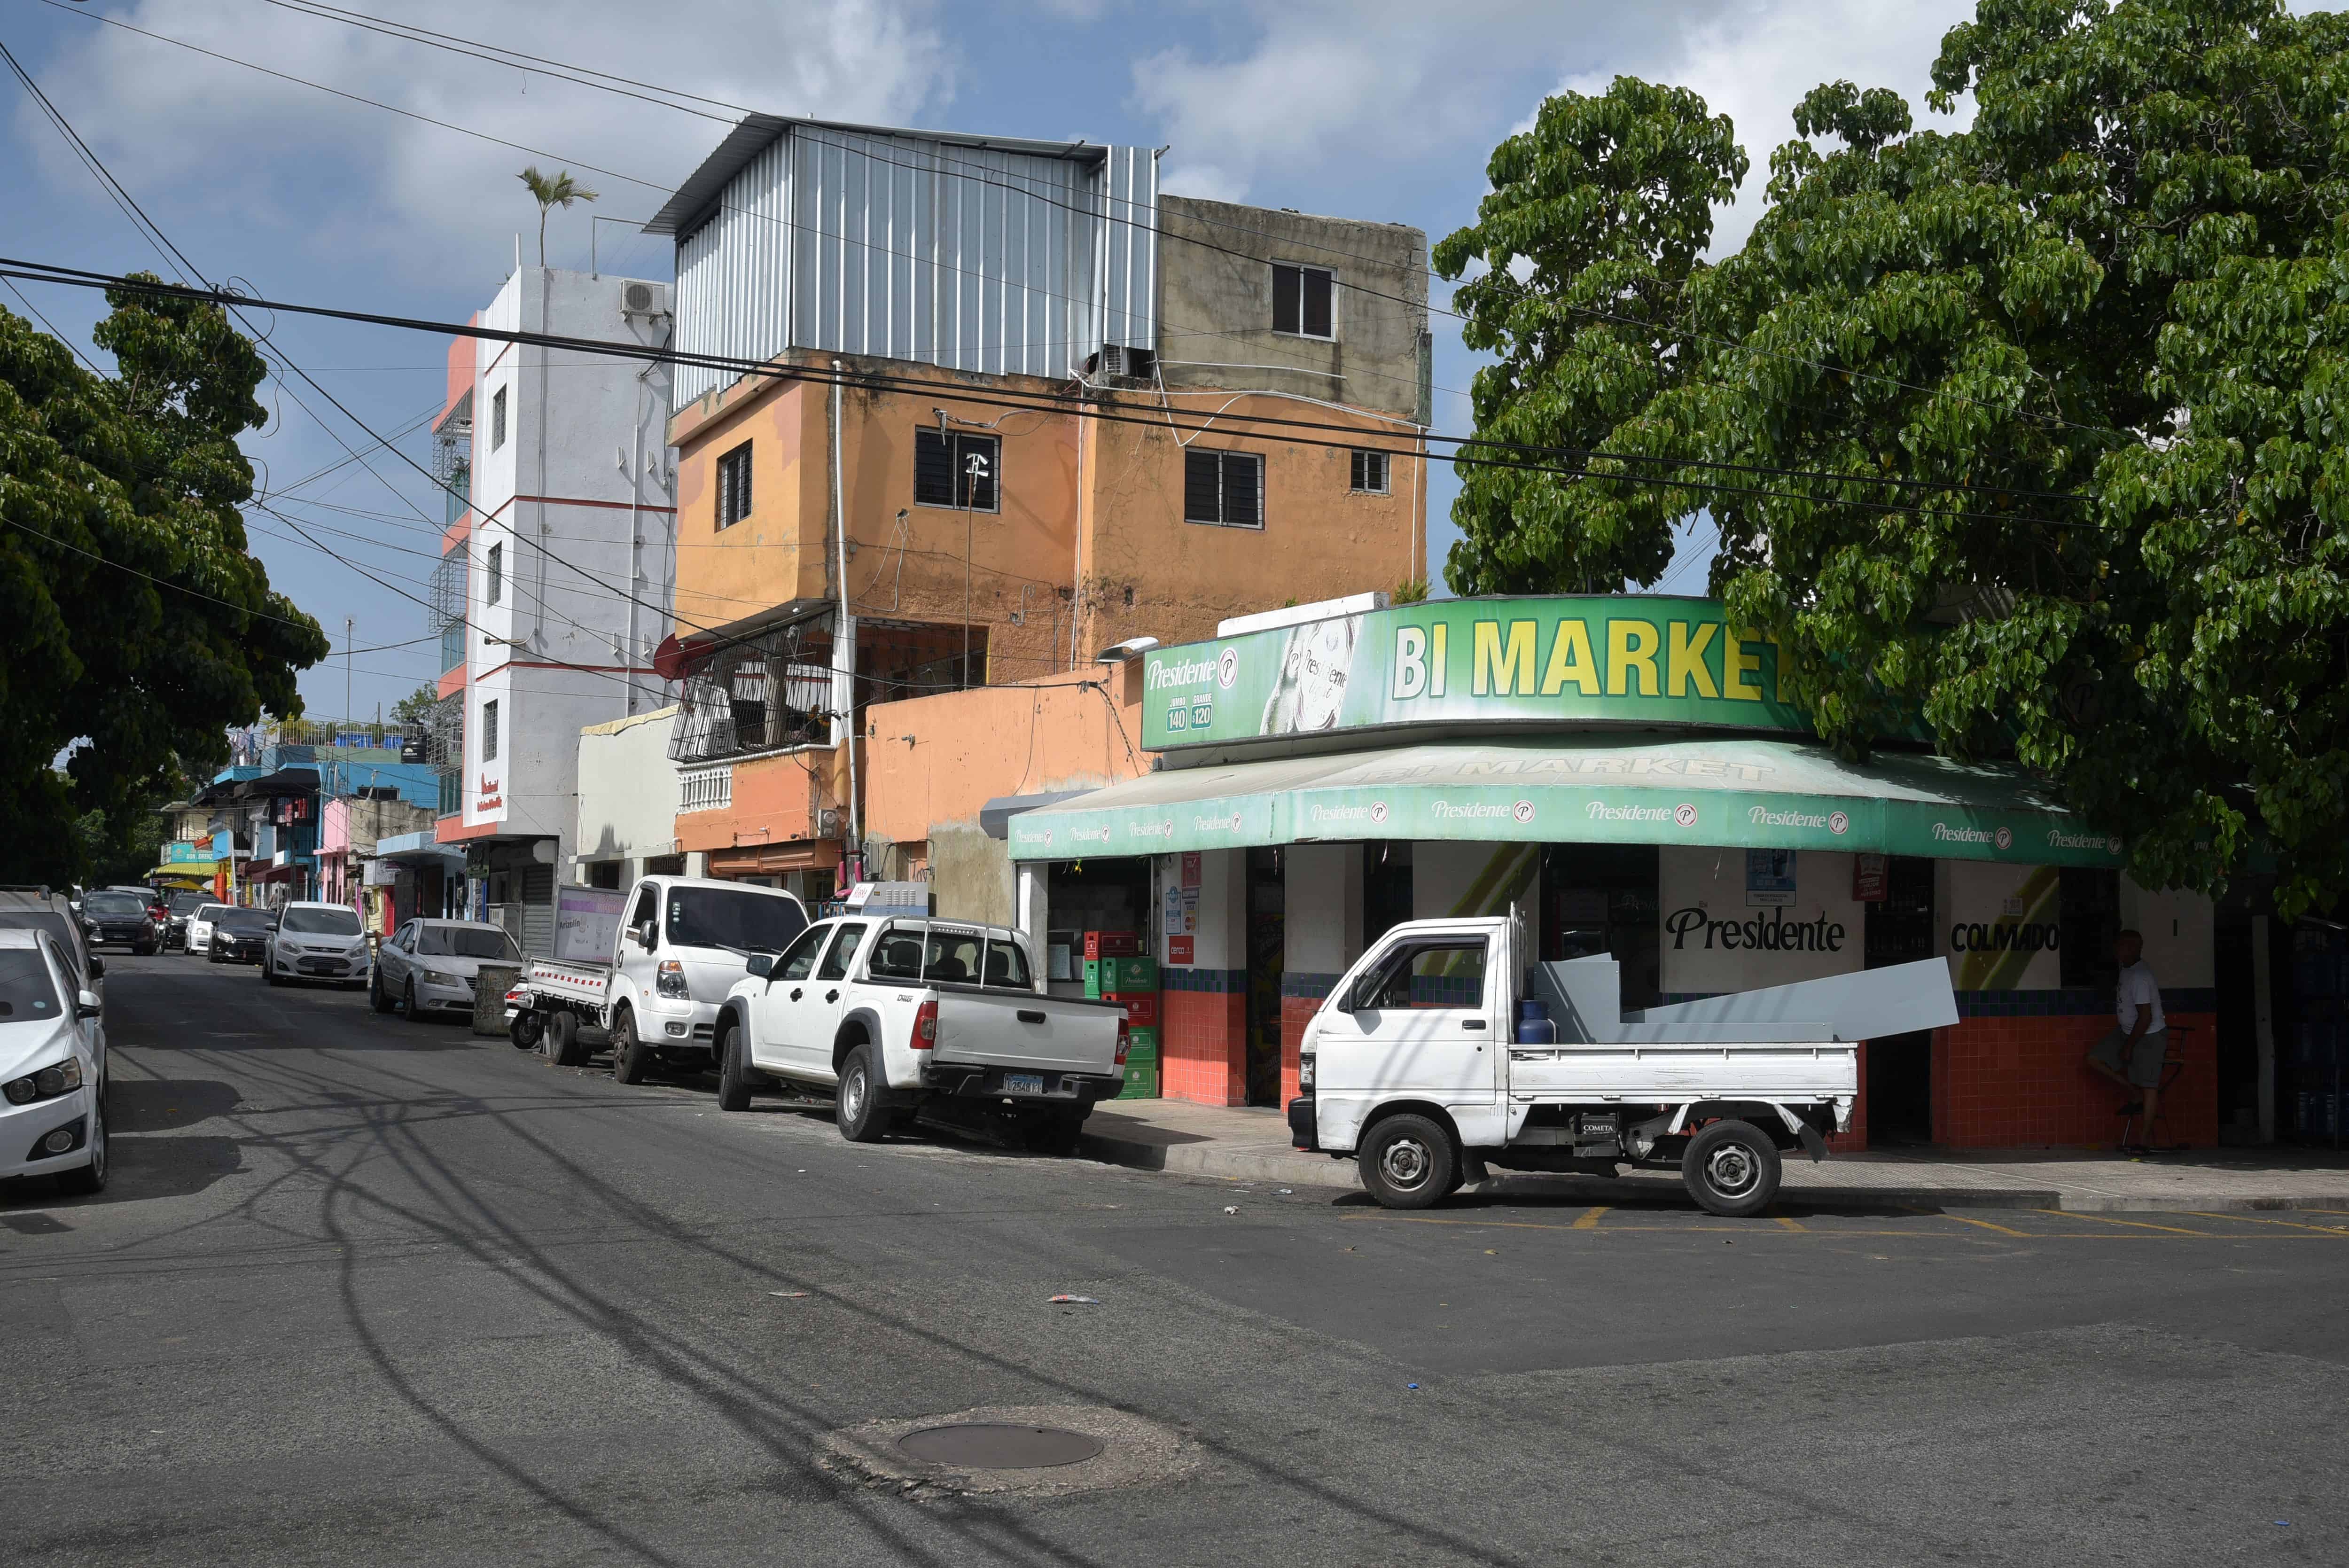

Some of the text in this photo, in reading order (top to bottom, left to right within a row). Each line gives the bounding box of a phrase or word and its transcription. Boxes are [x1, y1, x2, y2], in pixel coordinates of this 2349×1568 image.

[1392, 621, 1448, 701] BI
[1147, 657, 1216, 690] Presidente
[1170, 693, 1212, 707] JUMBO GRANDE
[1168, 706, 1210, 729] 140 $120
[1359, 758, 1774, 782] BI MARKET
[1311, 804, 1367, 821] Presidente
[1431, 801, 1510, 819] Presidente
[1586, 801, 1671, 821] Presidente
[1748, 806, 1826, 828] Presidente
[1070, 826, 1100, 842] Presidente
[1129, 822, 1163, 838] Presidente
[1194, 816, 1230, 832] Presidente
[1932, 822, 1993, 843] Presidente
[1015, 829, 1043, 844] Presidente
[2047, 829, 2106, 849] Presidente
[559, 918, 580, 930] Arizolín
[1666, 907, 1845, 952] Presidente
[1951, 922, 2060, 952] COLMADO
